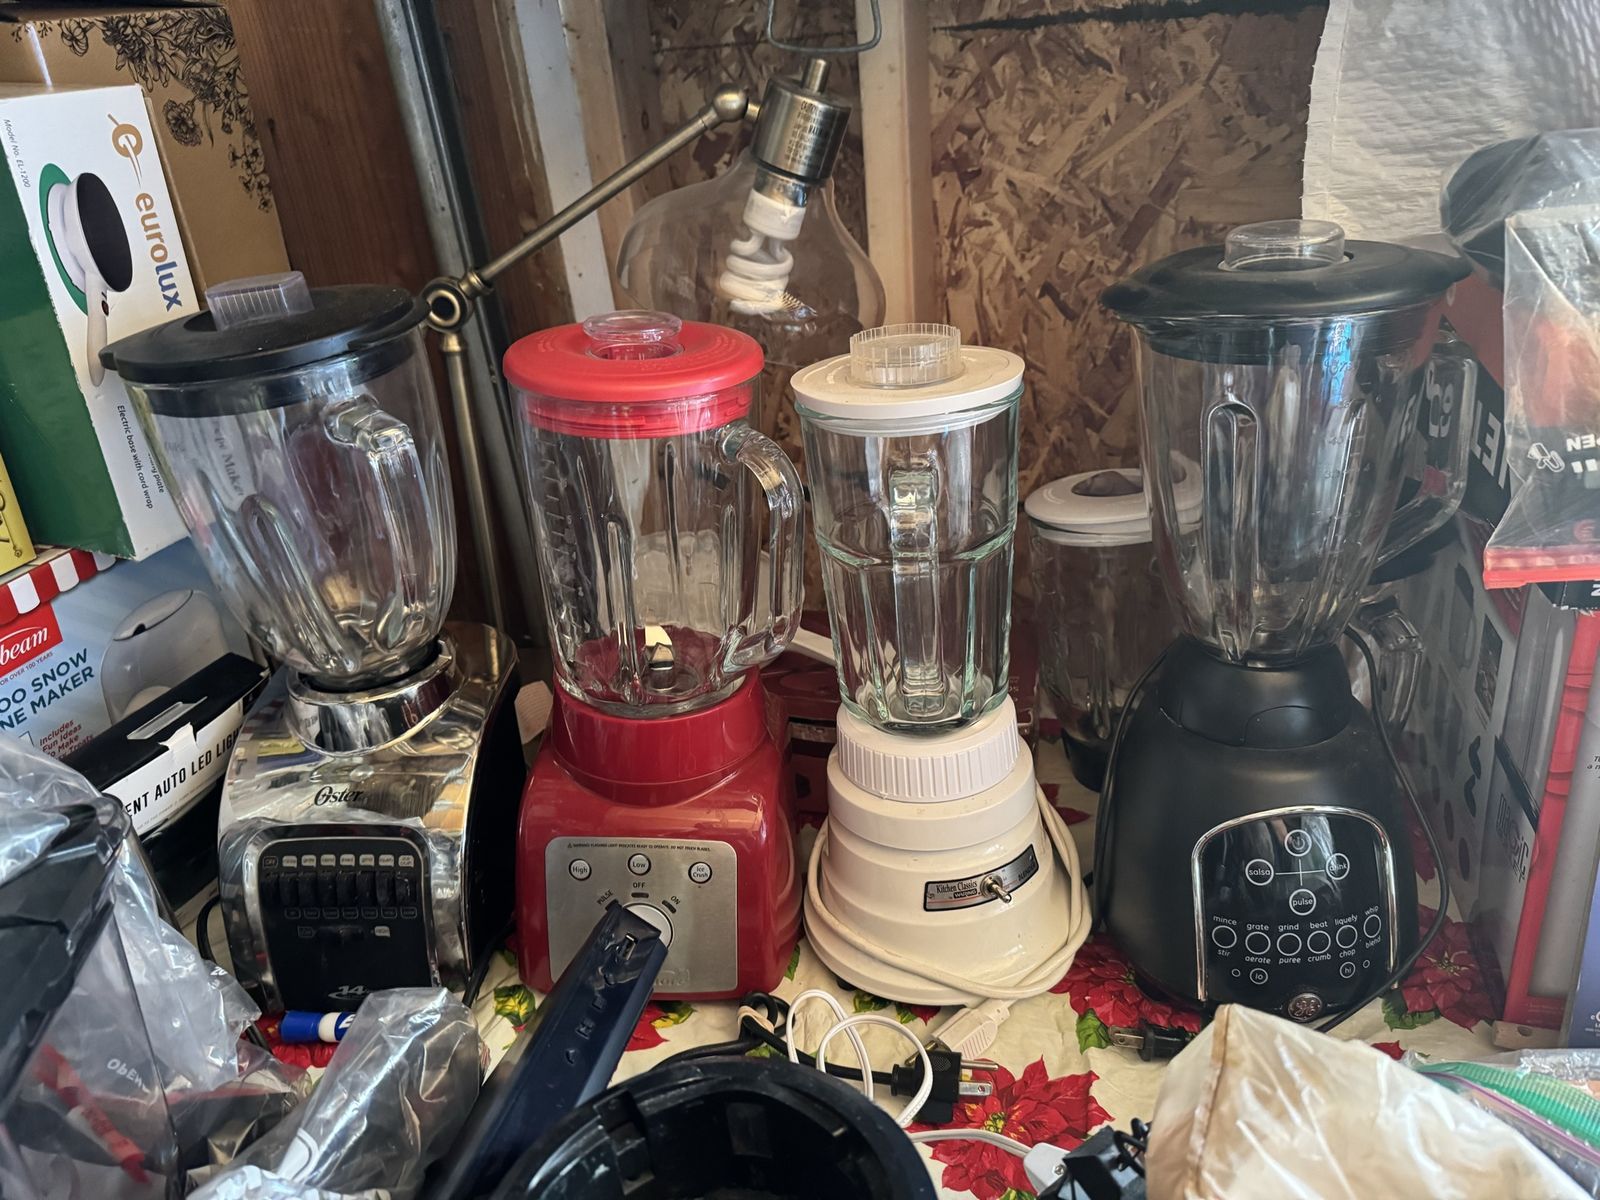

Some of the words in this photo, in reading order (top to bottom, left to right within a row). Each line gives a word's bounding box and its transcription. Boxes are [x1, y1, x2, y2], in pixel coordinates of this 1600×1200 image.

[4, 119, 17, 143] Model
[16, 159, 31, 188] EL-1200
[135, 192, 183, 312] eurolux
[117, 405, 131, 434] Electric
[126, 434, 137, 453] base
[133, 453, 142, 472] with
[138, 471, 149, 489] cord
[153, 472, 165, 493] plate
[143, 489, 154, 509] wrap
[10, 668, 25, 680] OVER
[26, 661, 36, 671] 100
[36, 651, 54, 664] YEARS
[31, 647, 88, 693] SNOW
[29, 665, 95, 715] MAKER
[40, 719, 74, 746] Includes
[60, 723, 82, 742] Ideas
[57, 734, 79, 753] Make
[124, 791, 150, 817] ENT
[154, 767, 187, 801] AUTO
[190, 749, 212, 776] LED
[313, 785, 364, 807] Oster
[572, 865, 588, 875] High
[632, 860, 646, 868] Low
[692, 871, 709, 879] Crush
[1248, 868, 1272, 877] salsa
[936, 883, 957, 894] Kitchen
[957, 880, 978, 891] Classics
[670, 895, 681, 905] ON
[1292, 896, 1314, 907] pulse
[1364, 904, 1380, 916] whip
[1212, 915, 1238, 926] mince
[1309, 920, 1328, 929] beat
[1246, 923, 1270, 932] grate
[1278, 923, 1300, 932] grind
[1365, 935, 1382, 950] blend
[1217, 948, 1231, 957] stir
[1307, 954, 1332, 963] crumb
[1339, 948, 1357, 959] chop
[1244, 955, 1272, 965] aerate
[1278, 957, 1302, 965] puree
[1344, 966, 1352, 974] hi
[1255, 972, 1263, 981] lo
[338, 985, 365, 996] 14
